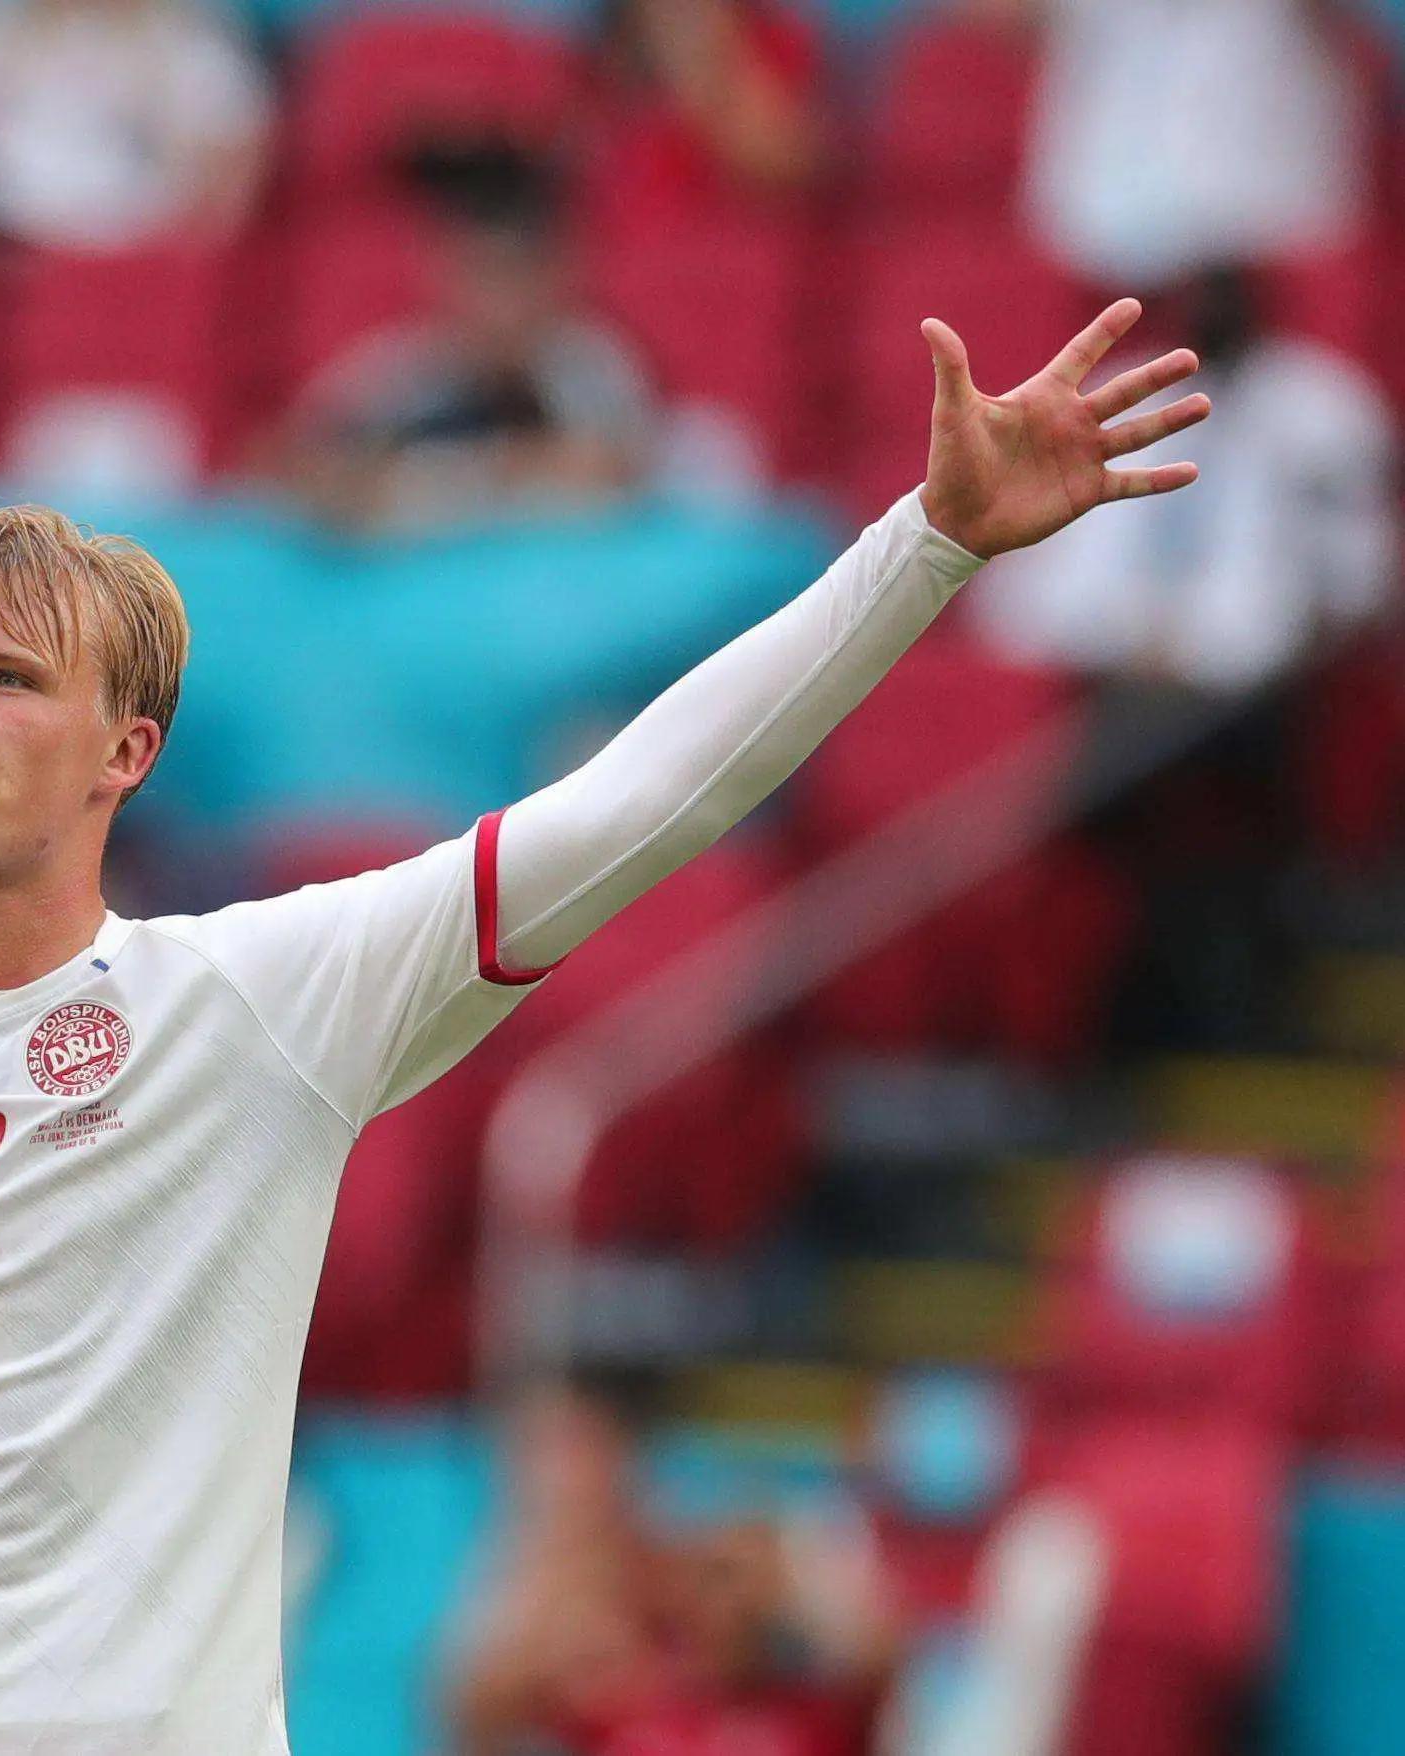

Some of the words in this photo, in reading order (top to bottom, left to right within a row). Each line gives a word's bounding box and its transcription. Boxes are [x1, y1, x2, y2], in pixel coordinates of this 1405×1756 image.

[28, 1048, 65, 1095] DANSK
[111, 1019, 129, 1067] UNION
[46, 1029, 112, 1074] DBU
[77, 1108, 119, 1127] DENMARK
